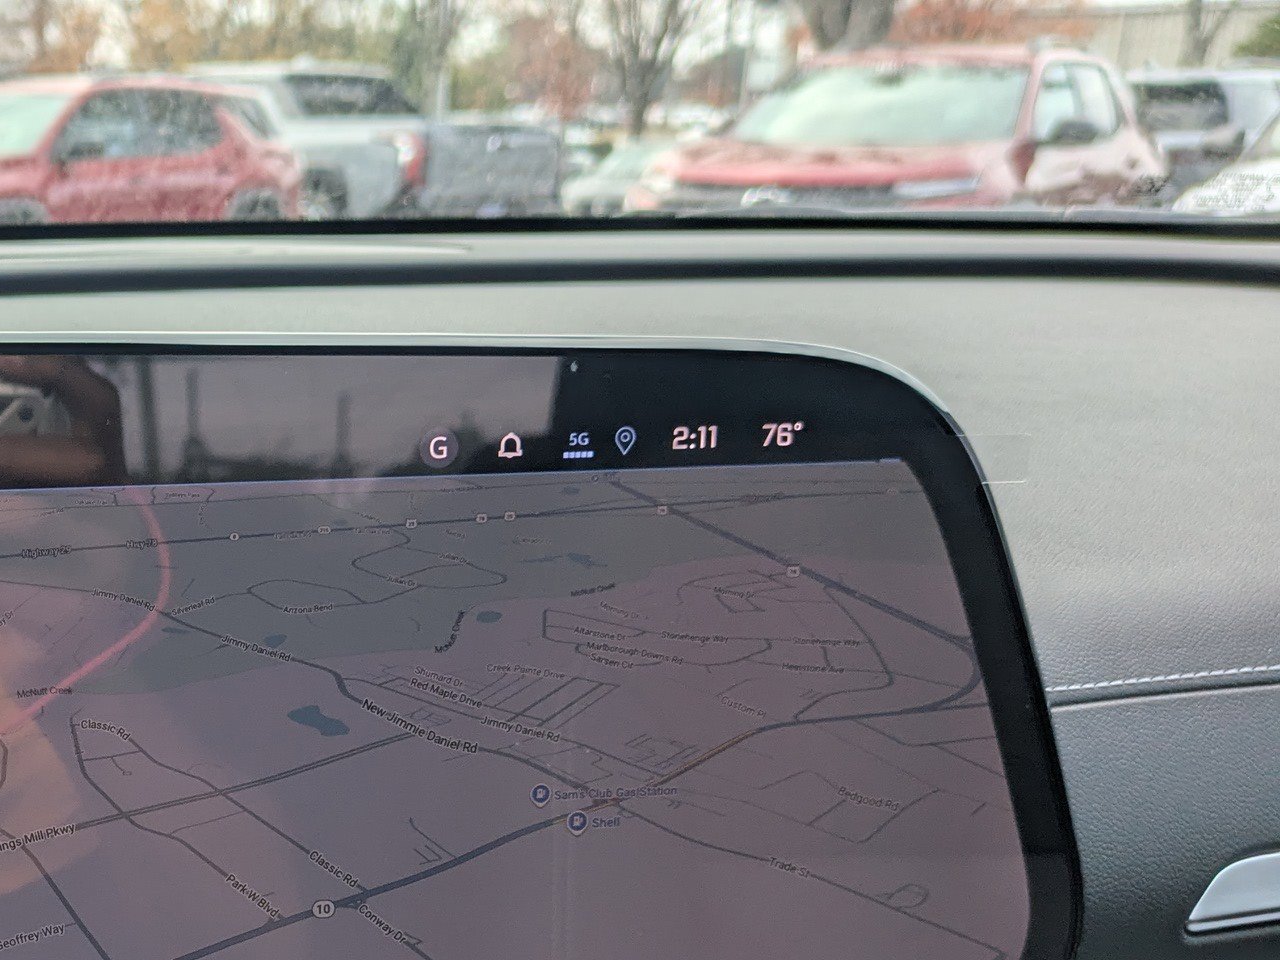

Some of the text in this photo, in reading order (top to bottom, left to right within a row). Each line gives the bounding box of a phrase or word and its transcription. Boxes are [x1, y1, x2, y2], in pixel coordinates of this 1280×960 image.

[569, 432, 589, 446] 5G
[672, 425, 718, 450] 2:11
[762, 420, 804, 447] 76°
[429, 436, 448, 459] G
[22, 548, 58, 559] Highway
[126, 541, 145, 550] Hwy
[91, 588, 155, 612] Jimmy Daniel Rd
[171, 597, 215, 616] Silverleaf Rd
[313, 602, 333, 612] Bend
[3, 610, 14, 621] Dr
[574, 626, 616, 640] Altarstone
[661, 630, 711, 643] Stonehenge
[221, 635, 291, 662] Jimmy Daniel Rd
[587, 641, 639, 657] Marlborough
[590, 653, 620, 667] Sarsen
[486, 663, 510, 673] Creek
[543, 669, 566, 680] Drive
[17, 685, 73, 698] McNutt Creek
[410, 678, 483, 709] Red Maple Drive
[722, 696, 754, 713] Custom
[80, 718, 132, 741] Classic Rd
[362, 698, 478, 754] New Jimmie Daniel Rd
[480, 715, 560, 743] Jimmy Daniel Rd
[554, 785, 678, 800] Sam's Club Gas Station
[837, 786, 899, 811] Bedgood Rd
[592, 816, 621, 828] Shell
[23, 830, 44, 845] Mill
[45, 823, 76, 840] Pkwy
[309, 850, 358, 888] Classic Rd
[769, 857, 810, 878] Trade St
[226, 873, 279, 918] Park W Blvd
[316, 904, 330, 915] 10
[40, 923, 65, 938] Way
[359, 904, 407, 943] Conway Dr
